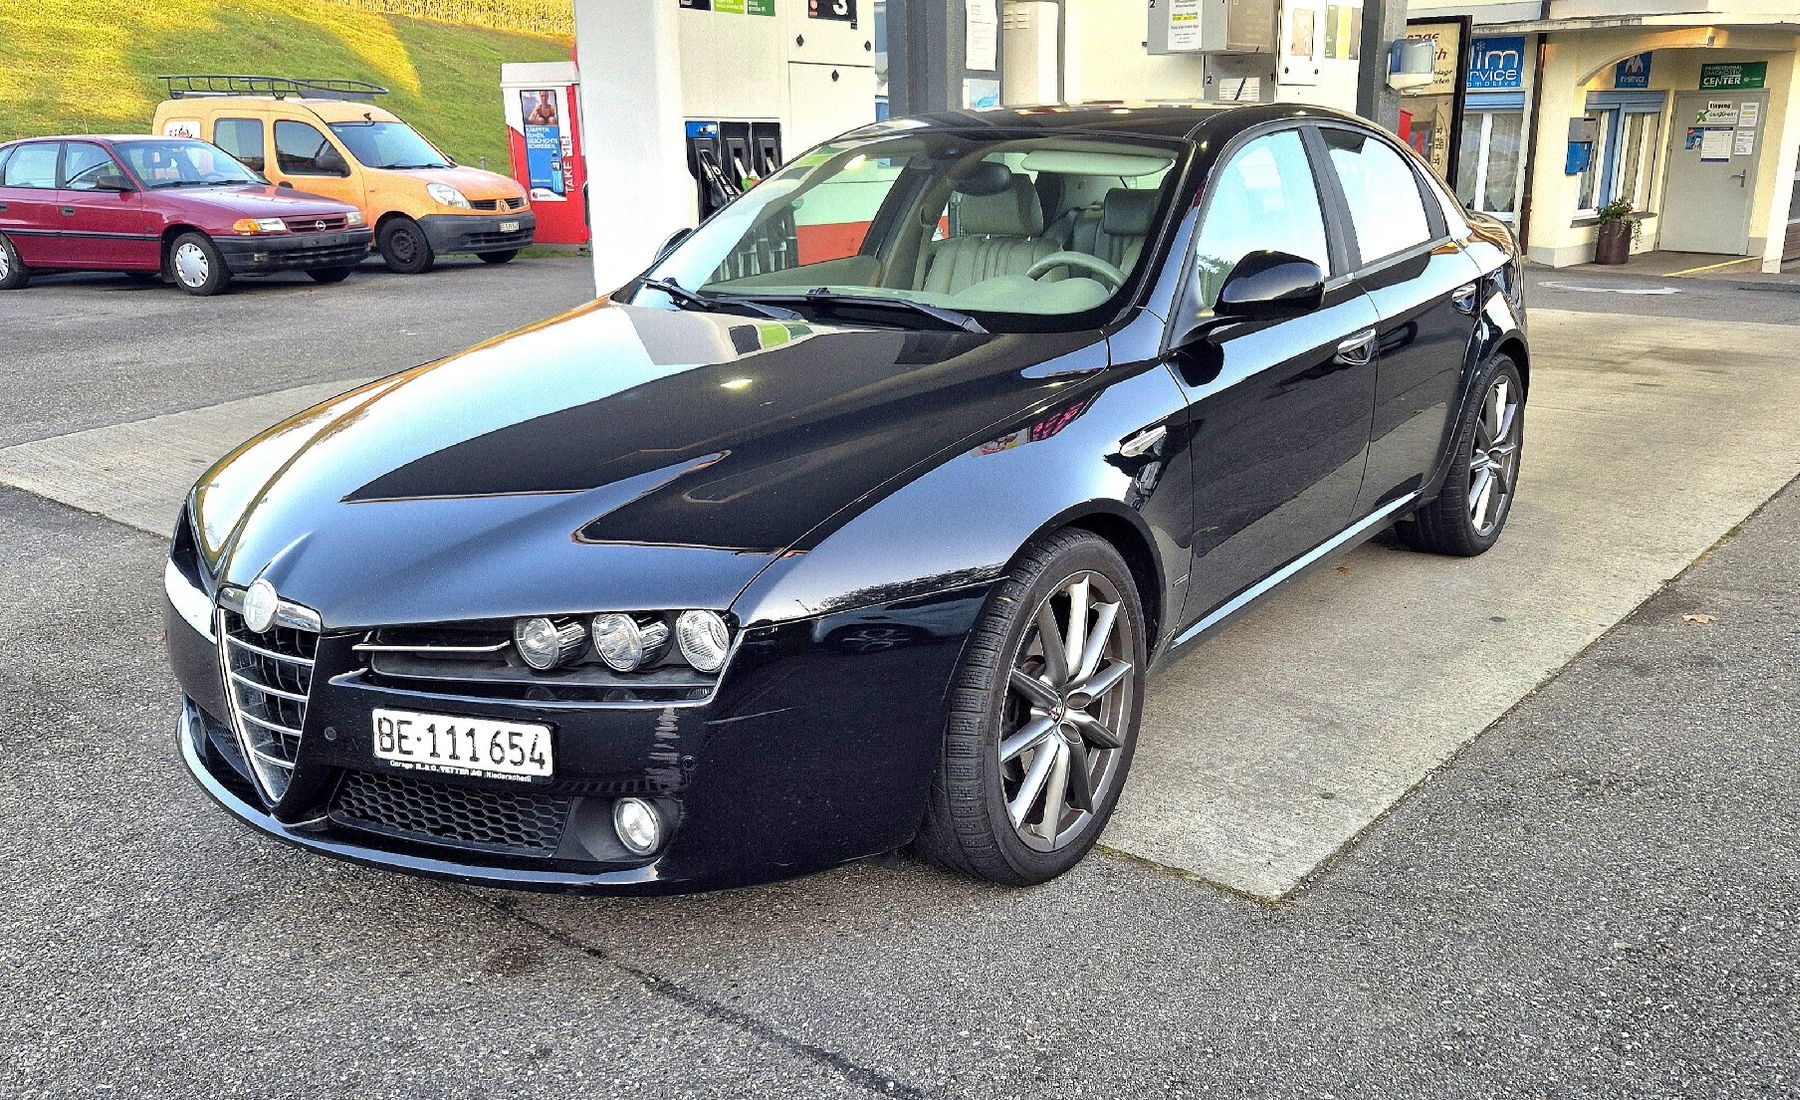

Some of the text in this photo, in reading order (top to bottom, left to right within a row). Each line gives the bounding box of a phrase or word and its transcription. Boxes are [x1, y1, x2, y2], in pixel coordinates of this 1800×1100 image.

[1469, 66, 1517, 81] rvice
[1702, 75, 1741, 87] CENTER
[563, 161, 575, 193] TAKE
[390, 759, 414, 770] Garage
